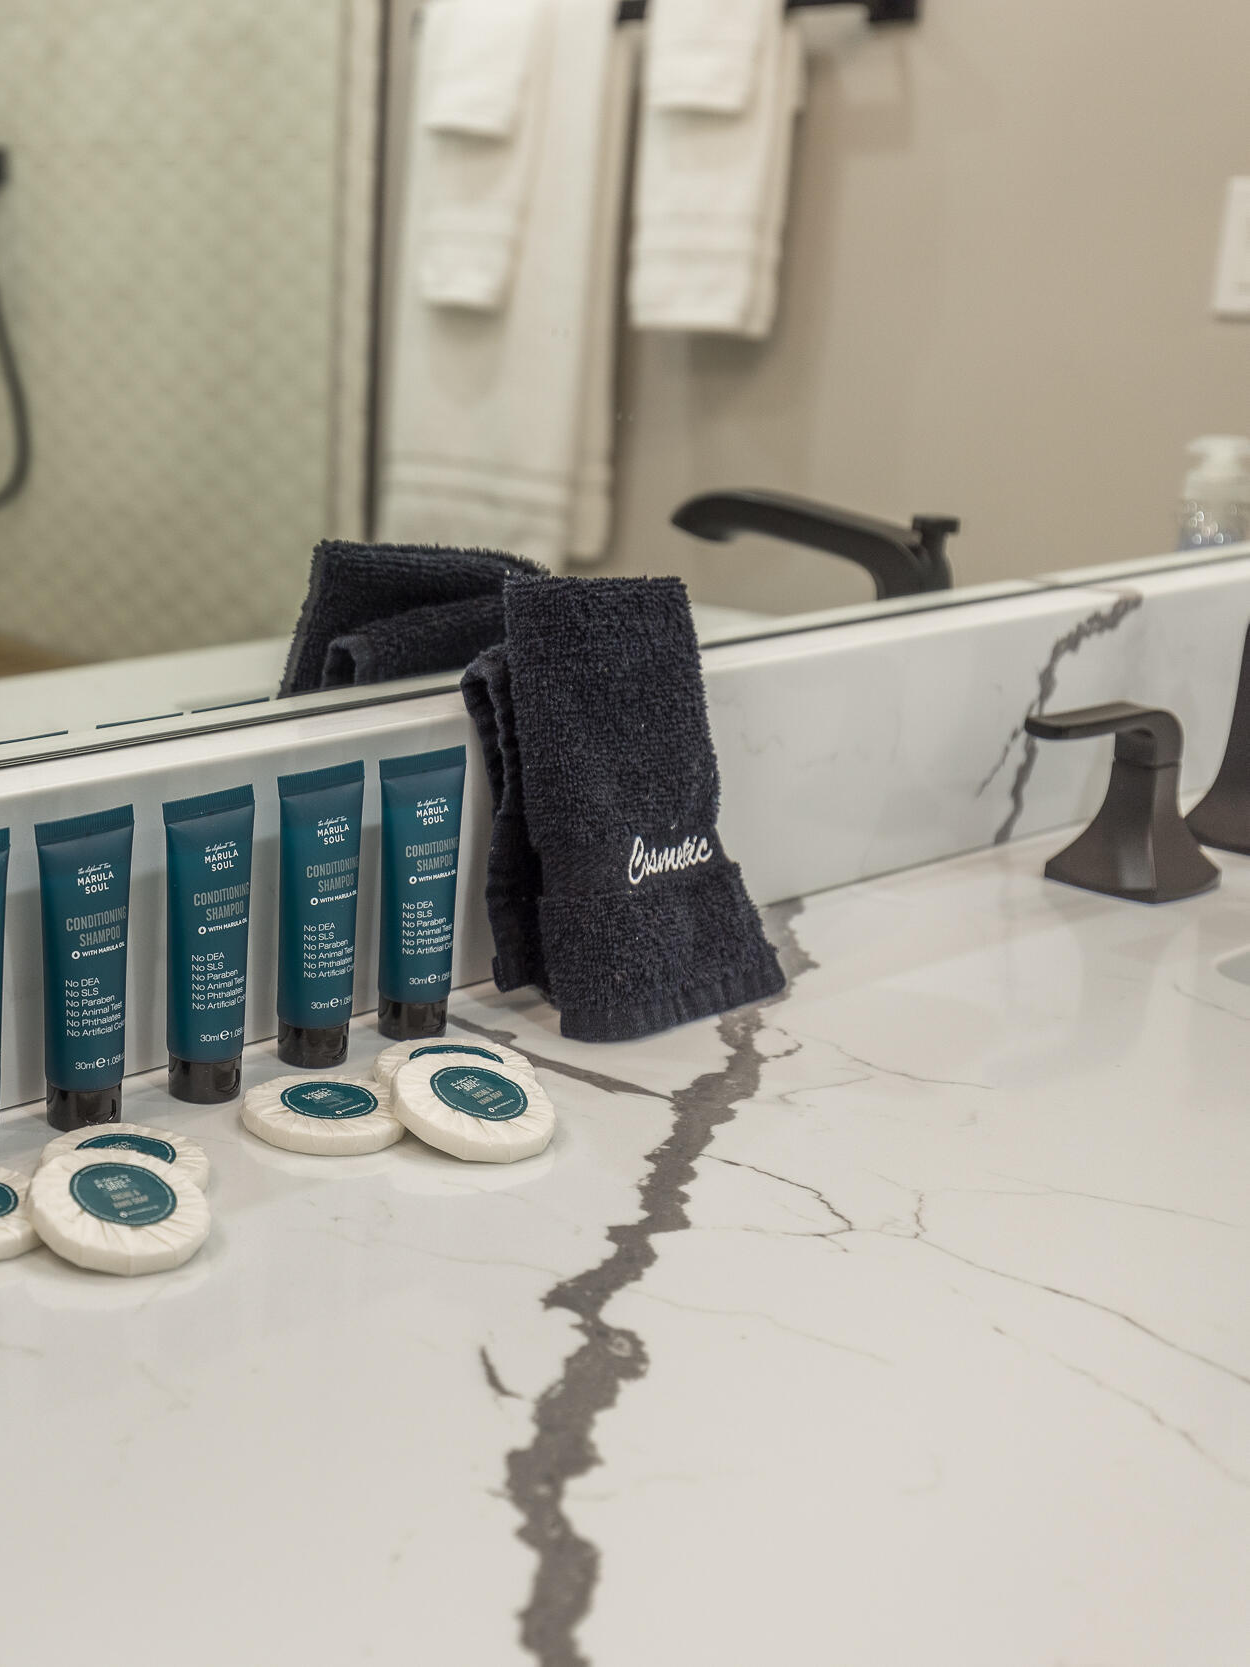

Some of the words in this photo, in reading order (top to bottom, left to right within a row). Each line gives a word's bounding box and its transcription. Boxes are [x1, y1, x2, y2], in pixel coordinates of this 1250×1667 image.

[417, 805, 449, 818] MARULA
[423, 815, 444, 825] SOUL
[318, 824, 350, 837] MARULA
[324, 835, 345, 845] SOUL
[205, 849, 238, 864] MARULA
[628, 835, 713, 885] Cosmetic
[211, 860, 234, 872] SOUL
[417, 854, 453, 872] SHAMPOO
[77, 871, 114, 886] MARULA
[318, 873, 354, 893] SHAMPOO
[85, 883, 109, 894] SOUL
[206, 901, 244, 921] SHAMPOO
[417, 901, 433, 910] DEA
[66, 905, 126, 932] CONDITIONING
[417, 910, 432, 919] SLS
[319, 922, 335, 931] DEA
[417, 917, 446, 927] Paraben
[208, 924, 222, 932] WITH
[417, 927, 441, 936] Animal
[79, 925, 121, 947] SHAMPOO
[319, 932, 334, 940] SLS
[319, 939, 348, 950] Paraben
[82, 949, 97, 957] WITH
[192, 954, 205, 962] No
[207, 952, 224, 961] DEA
[318, 949, 343, 959] Animal
[192, 964, 205, 972] No
[207, 962, 224, 970] SLS
[207, 969, 238, 981] Paraben
[81, 978, 100, 987] DEA
[207, 979, 233, 990] Animal
[81, 987, 99, 997] SLS
[82, 995, 115, 1007] Paraben
[82, 1005, 109, 1017] Animal
